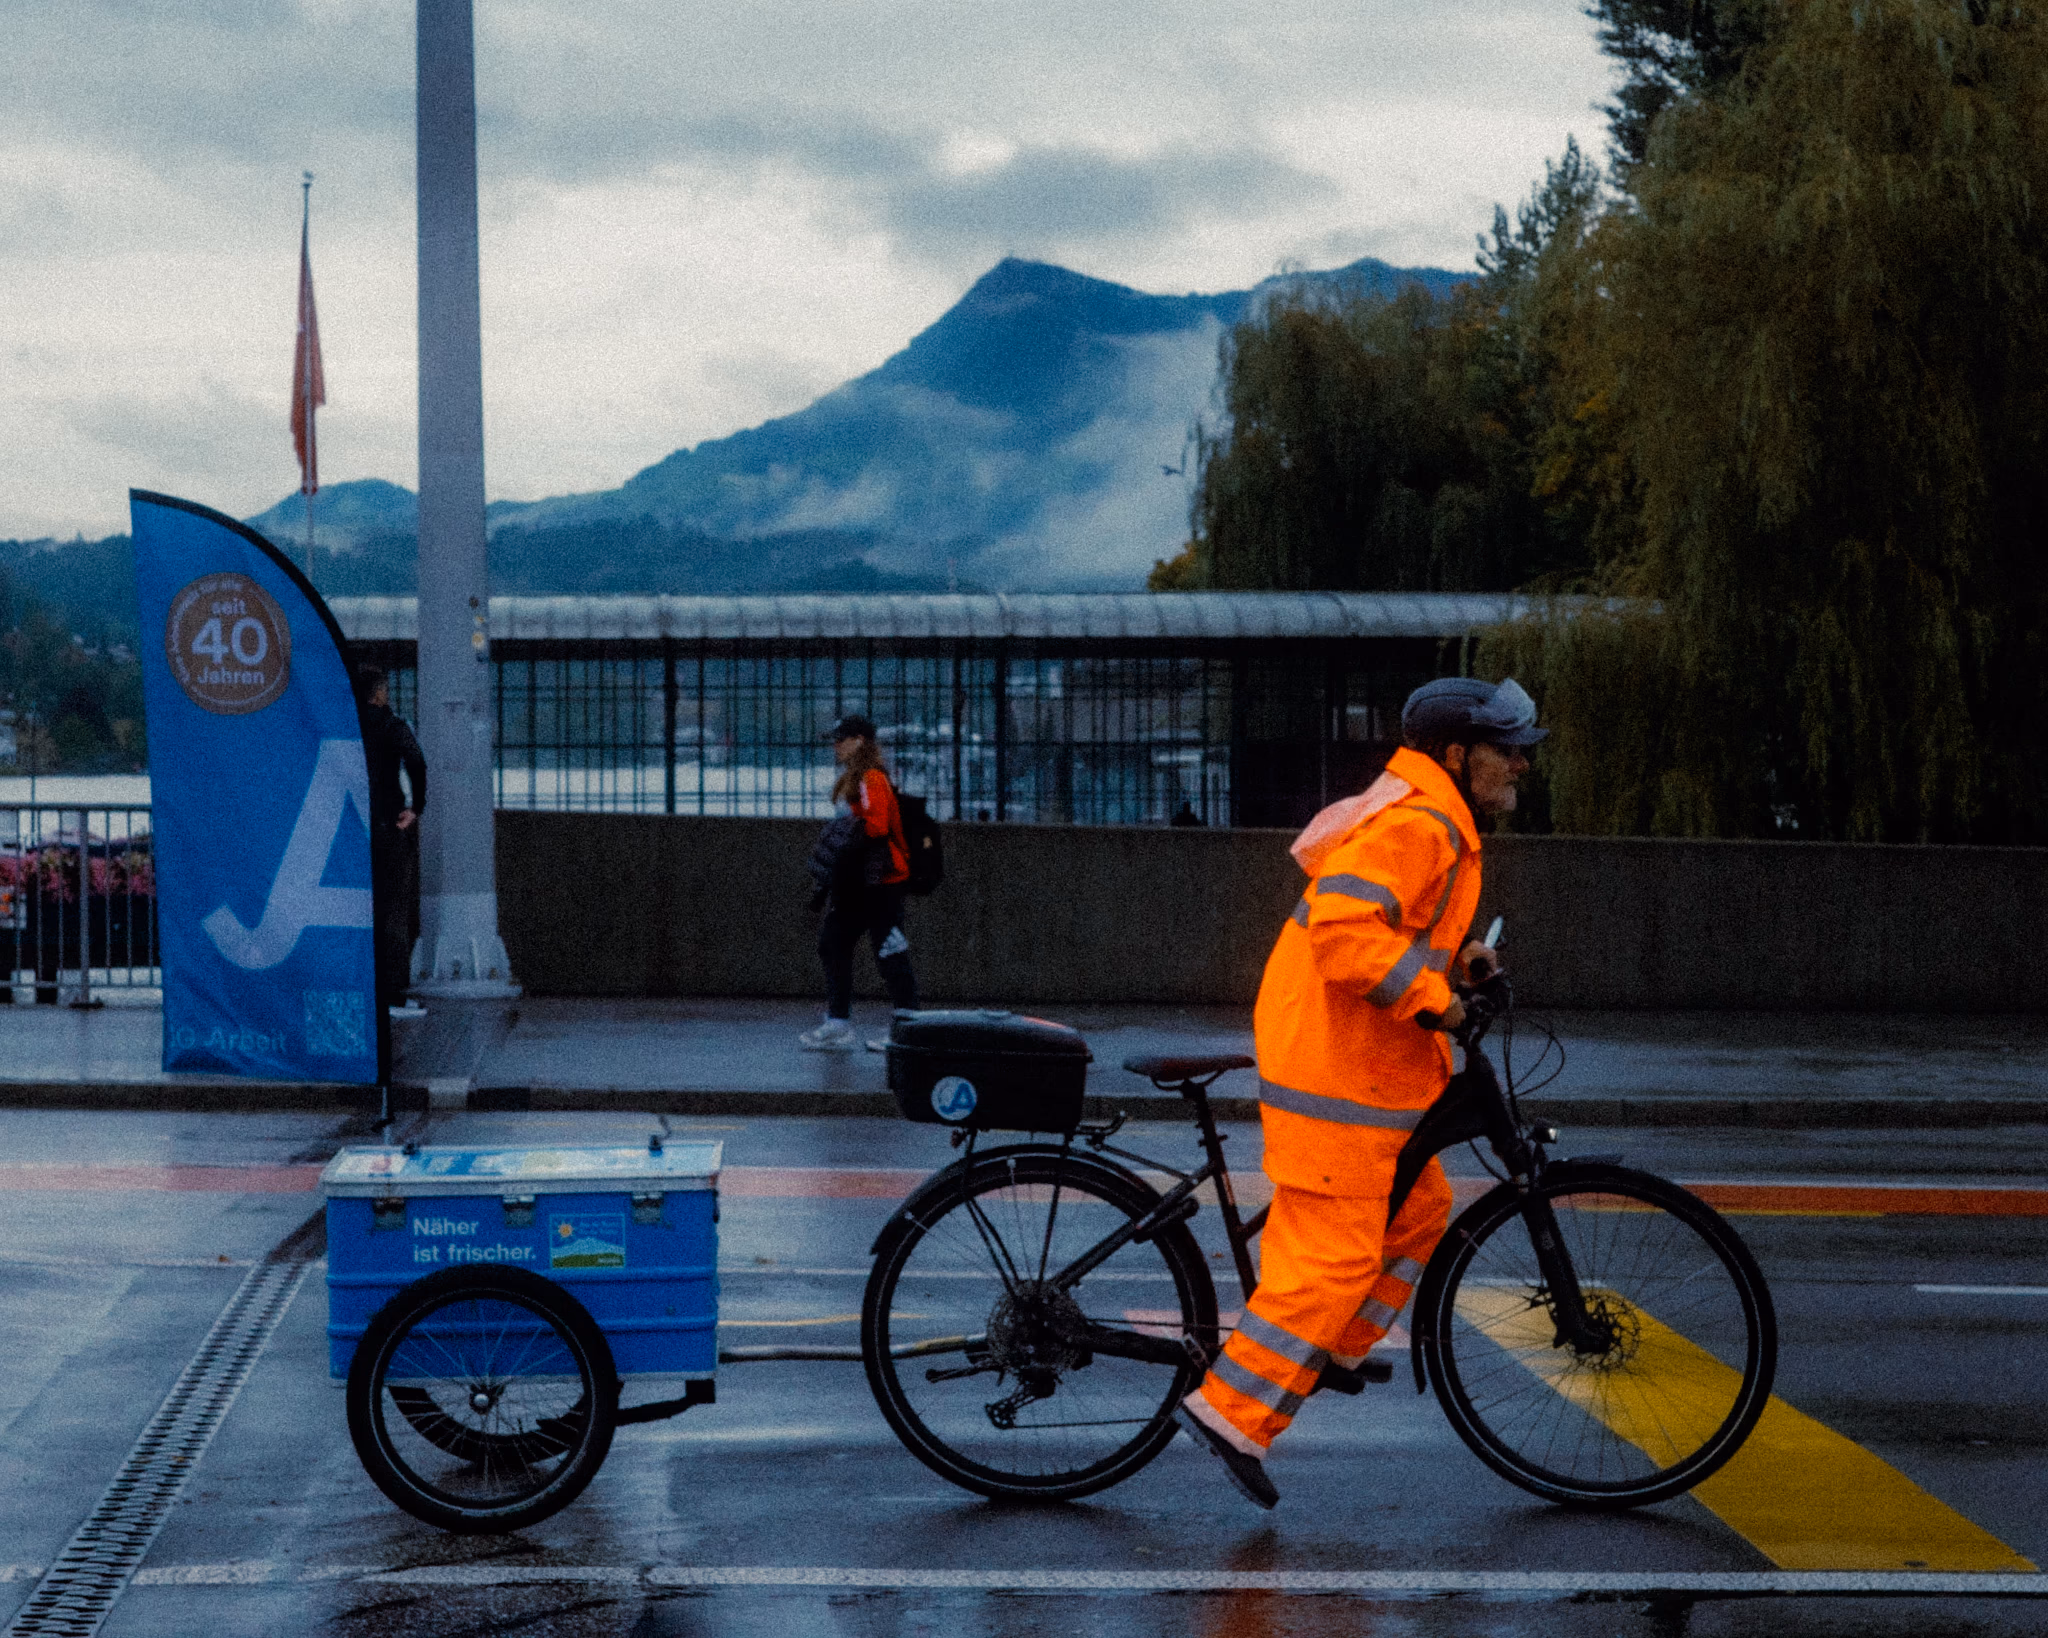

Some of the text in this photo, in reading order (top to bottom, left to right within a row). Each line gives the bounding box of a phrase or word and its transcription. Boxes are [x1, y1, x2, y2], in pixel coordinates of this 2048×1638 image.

[211, 598, 247, 615] seit
[191, 616, 268, 666] 40
[197, 666, 265, 684] Jahren
[203, 1024, 287, 1053] Arbeit
[413, 1217, 479, 1236] Näher
[414, 1243, 537, 1262] ist frischer.
